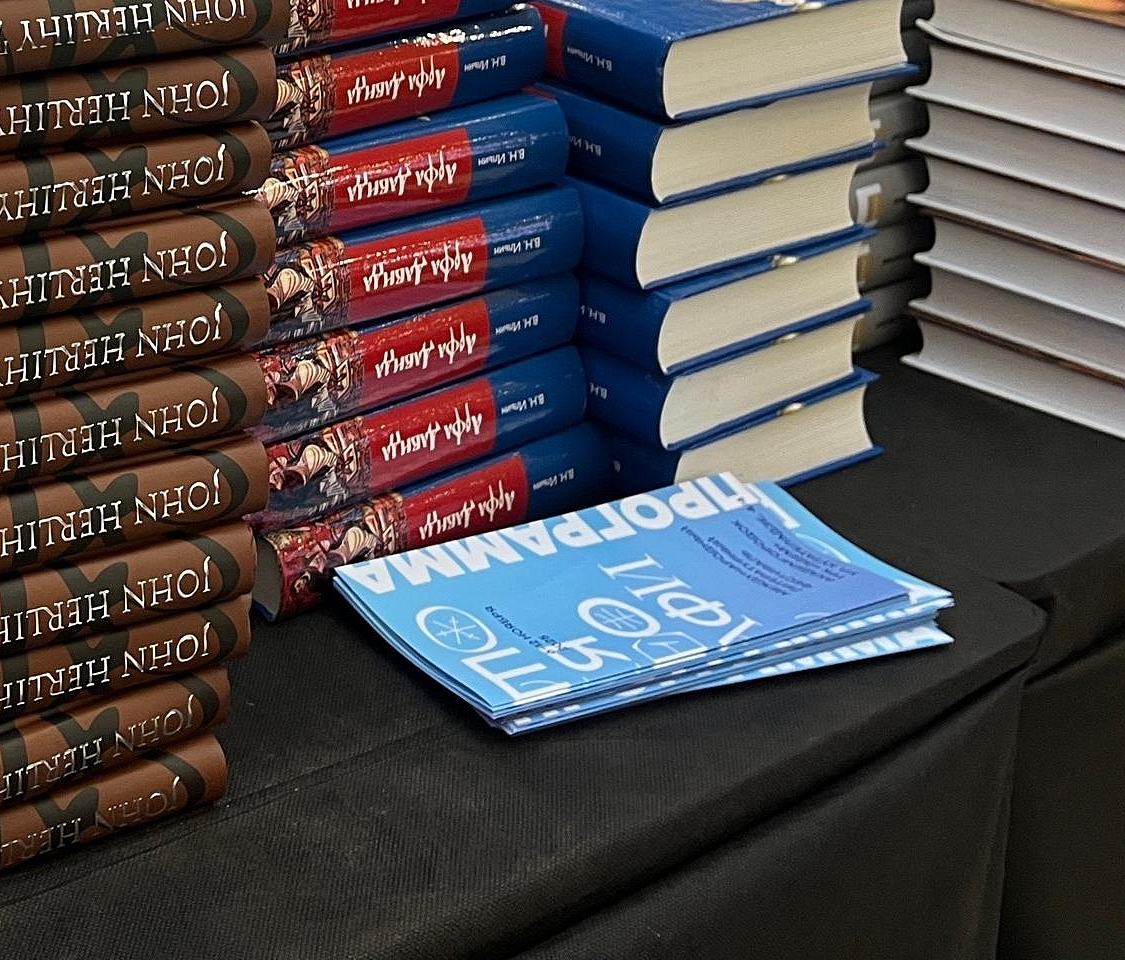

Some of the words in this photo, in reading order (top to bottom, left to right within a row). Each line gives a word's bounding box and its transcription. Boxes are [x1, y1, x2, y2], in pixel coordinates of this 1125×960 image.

[15, 2, 154, 52] HERLIHY
[142, 70, 229, 118] JOHN
[144, 143, 225, 195] JOHN
[143, 230, 227, 282] JOHN
[136, 303, 222, 357] JOHN
[133, 386, 219, 441] JOHN
[134, 468, 221, 524] JOHN
[340, 472, 756, 594] ПРОГРАММА
[122, 556, 211, 613] JOHN
[121, 622, 211, 678] JOHN
[114, 694, 195, 758] JOHN
